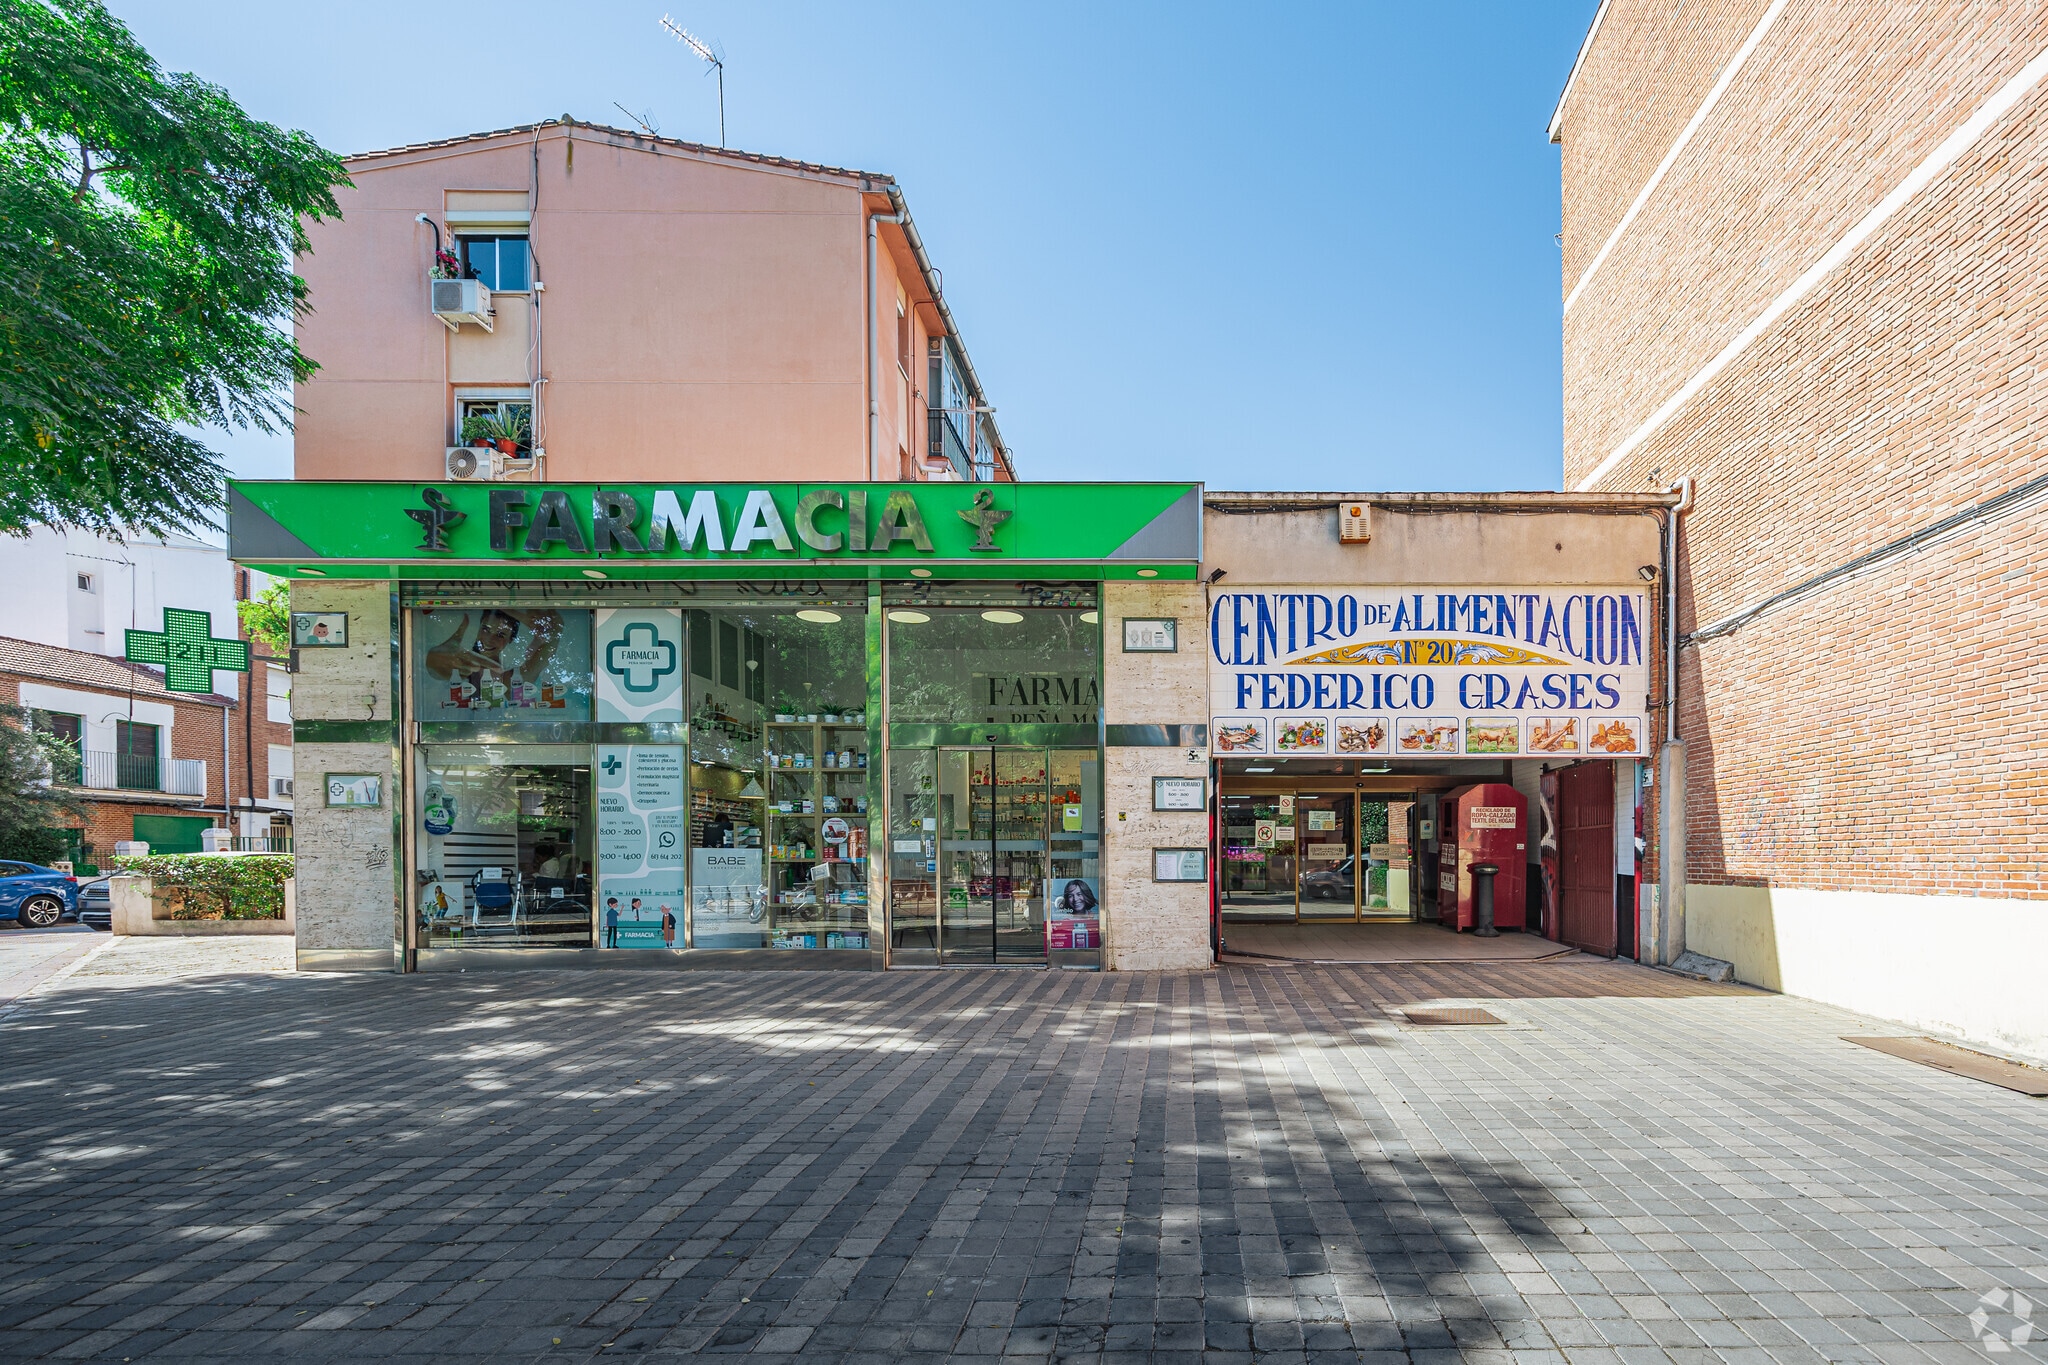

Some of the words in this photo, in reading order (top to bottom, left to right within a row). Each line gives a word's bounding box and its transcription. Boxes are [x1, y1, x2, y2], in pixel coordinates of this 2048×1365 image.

[489, 489, 935, 553] FARMACIA
[1211, 594, 1358, 666] CENTRO
[1363, 604, 1391, 626] DE
[1389, 594, 1644, 666] ALIMENTACION
[622, 650, 659, 660] FARMACIA
[1427, 641, 1453, 664] 20
[1235, 674, 1434, 710] FEDERICO
[1458, 674, 1621, 710] GRASES
